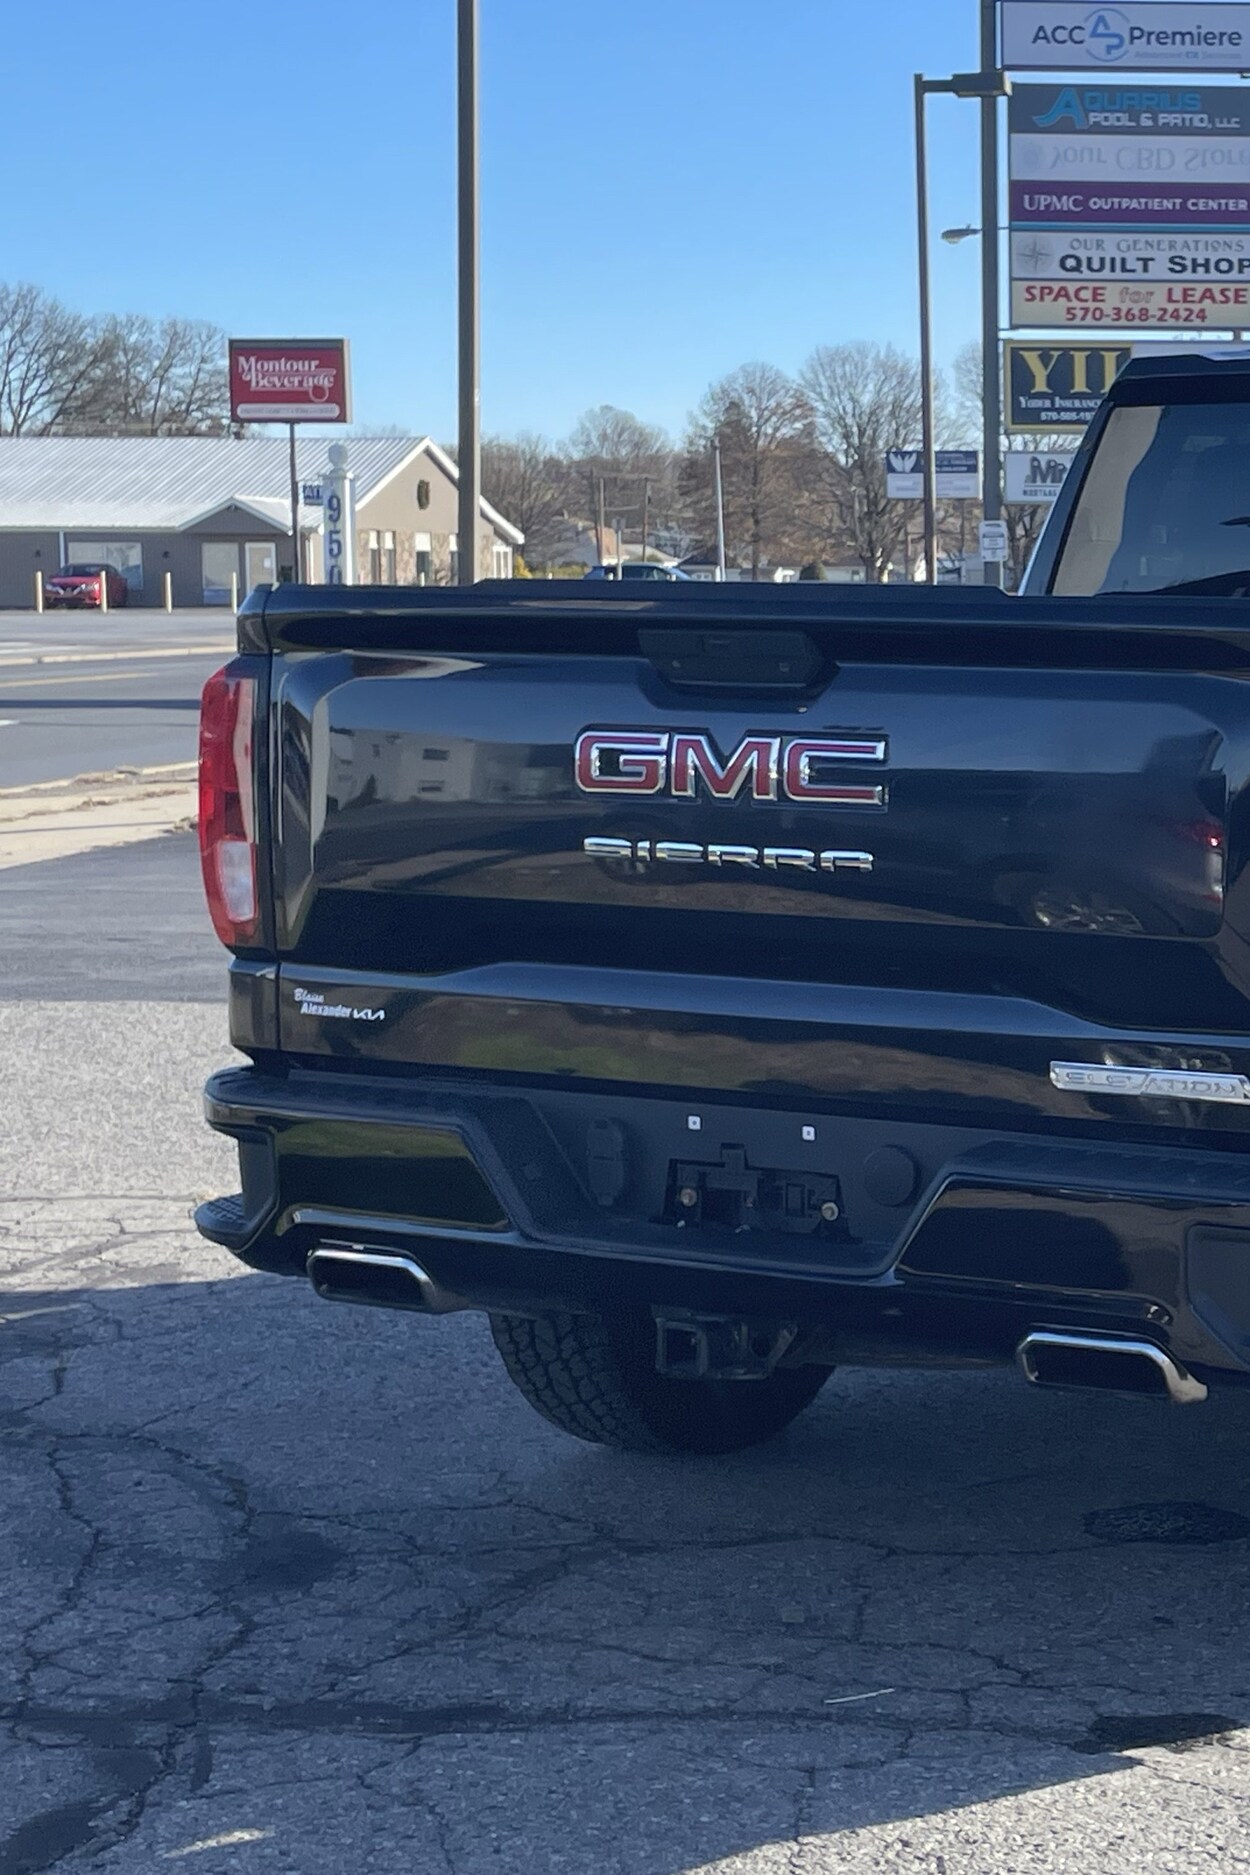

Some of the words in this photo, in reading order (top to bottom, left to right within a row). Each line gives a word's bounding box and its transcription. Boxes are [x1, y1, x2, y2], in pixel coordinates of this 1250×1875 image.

[1031, 24, 1086, 45] ACC
[1128, 24, 1243, 47] Premiere
[1031, 86, 1201, 130] AQUARIUS
[1089, 111, 1137, 127] POOL
[1139, 112, 1154, 127] &
[1157, 113, 1212, 129] PATIO,
[1214, 116, 1241, 128] LLC
[1023, 194, 1083, 212] UPMC
[1088, 198, 1183, 211] OUTPATIENT
[1187, 199, 1249, 212] CENTER
[1069, 238, 1105, 251] OUR
[1116, 238, 1246, 253] GENERATIONS
[1058, 253, 1155, 274] QUILT
[1024, 285, 1107, 303] SPACE
[1118, 287, 1155, 304] for
[1167, 287, 1249, 304] LEASE
[1065, 306, 1208, 323] 570-368-2424
[237, 355, 320, 375] Montour
[248, 372, 336, 403] Beverage
[575, 731, 886, 805] GMC
[584, 836, 874, 872] SIERRA
[300, 1002, 353, 1018] Alexander
